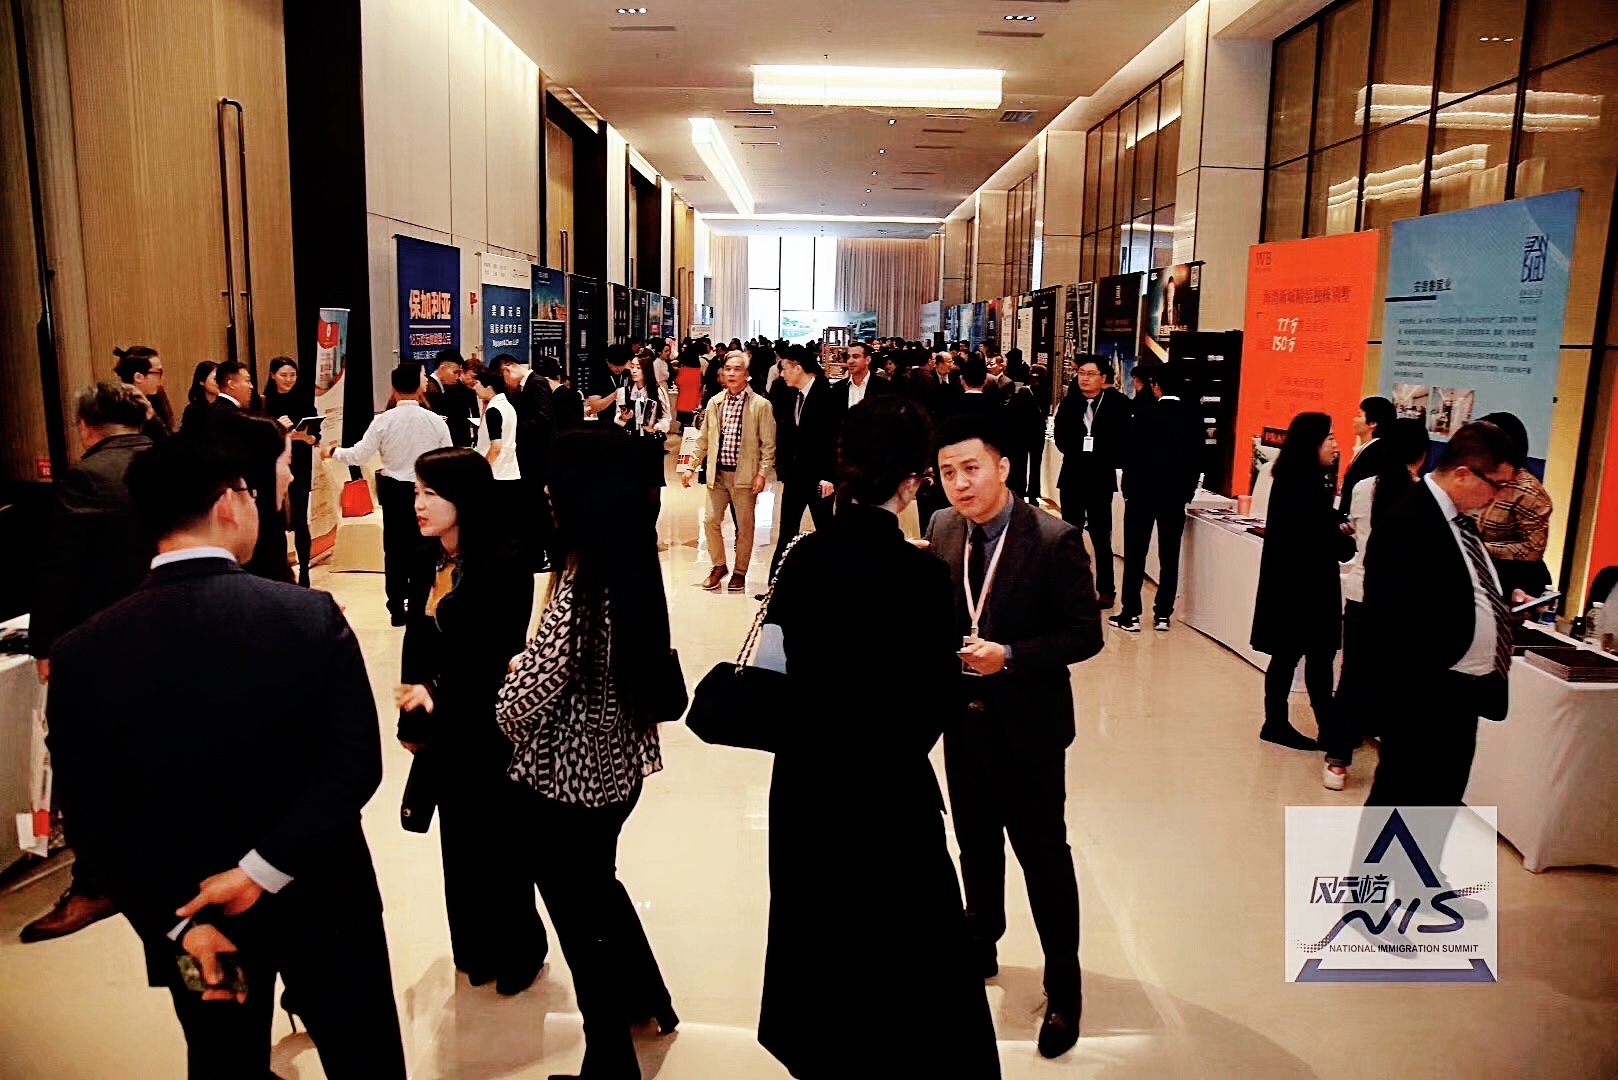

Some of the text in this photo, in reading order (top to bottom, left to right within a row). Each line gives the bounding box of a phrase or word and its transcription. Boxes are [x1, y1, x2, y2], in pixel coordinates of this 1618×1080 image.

[409, 289, 451, 320] 保加利亚
[1271, 335, 1297, 353] 150万
